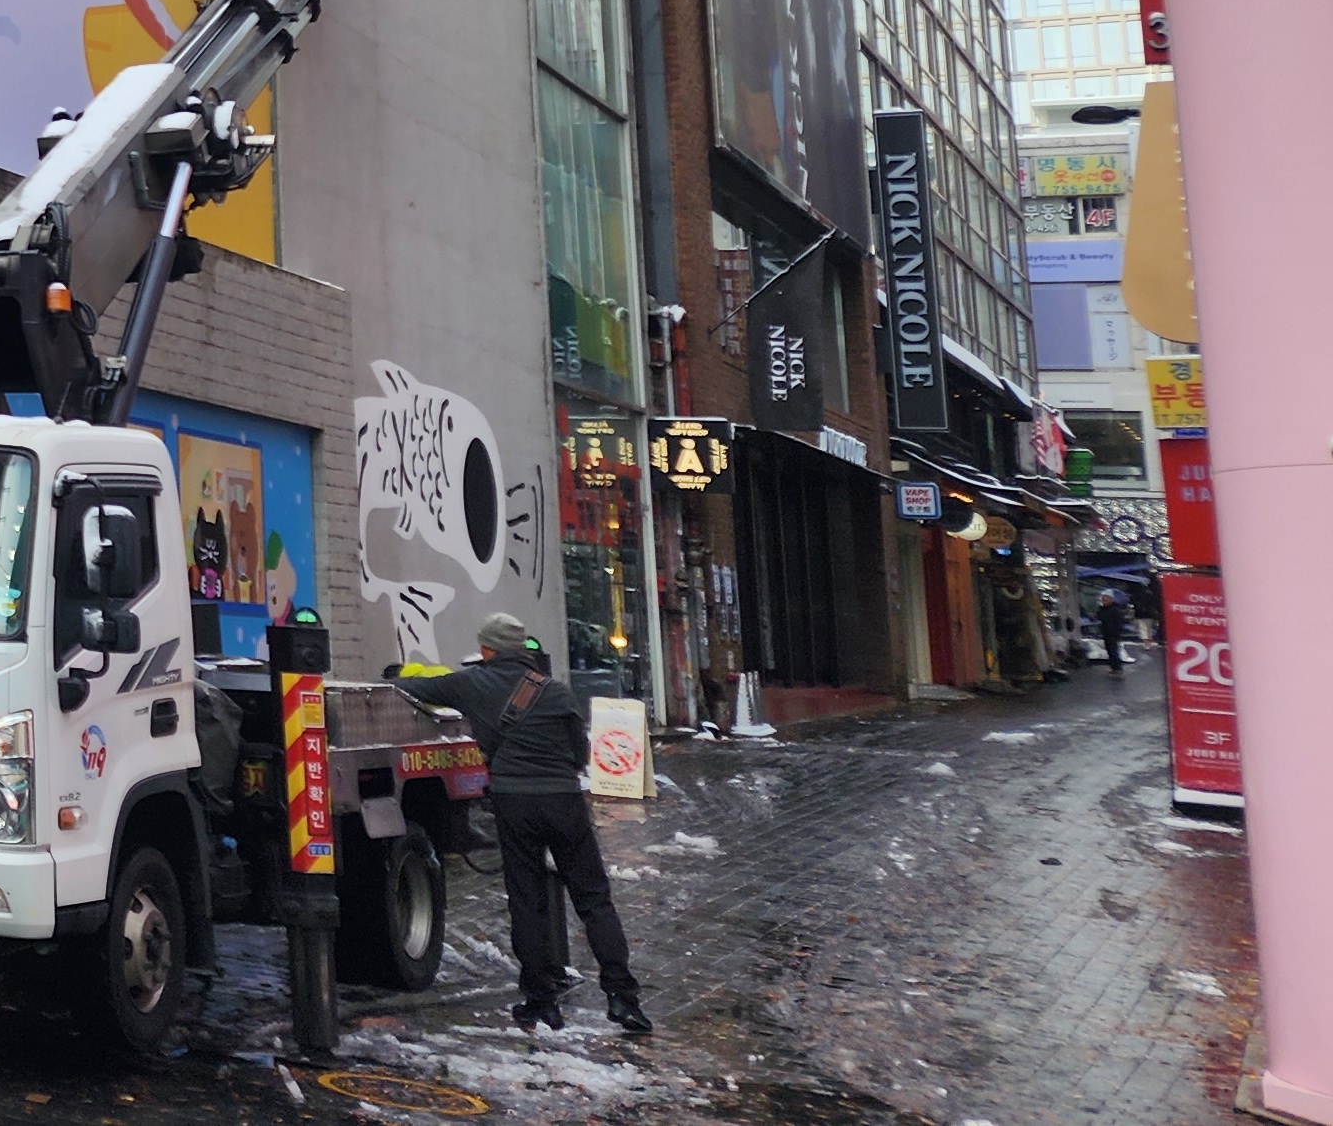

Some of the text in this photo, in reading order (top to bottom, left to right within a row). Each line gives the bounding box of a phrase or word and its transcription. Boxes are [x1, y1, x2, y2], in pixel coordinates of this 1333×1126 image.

[1086, 208, 1116, 227] 4F
[886, 152, 934, 389] NICK NICOLE
[768, 325, 789, 403] NICOLE
[788, 336, 806, 389] NICK
[1152, 382, 1206, 409] 부동
[904, 488, 930, 497] VAPE
[1181, 485, 1212, 502] HA
[1188, 593, 1223, 604] ONLY
[1171, 603, 1206, 615] FIRST
[151, 673, 182, 686] MIGHTY
[1202, 730, 1232, 745] 3F
